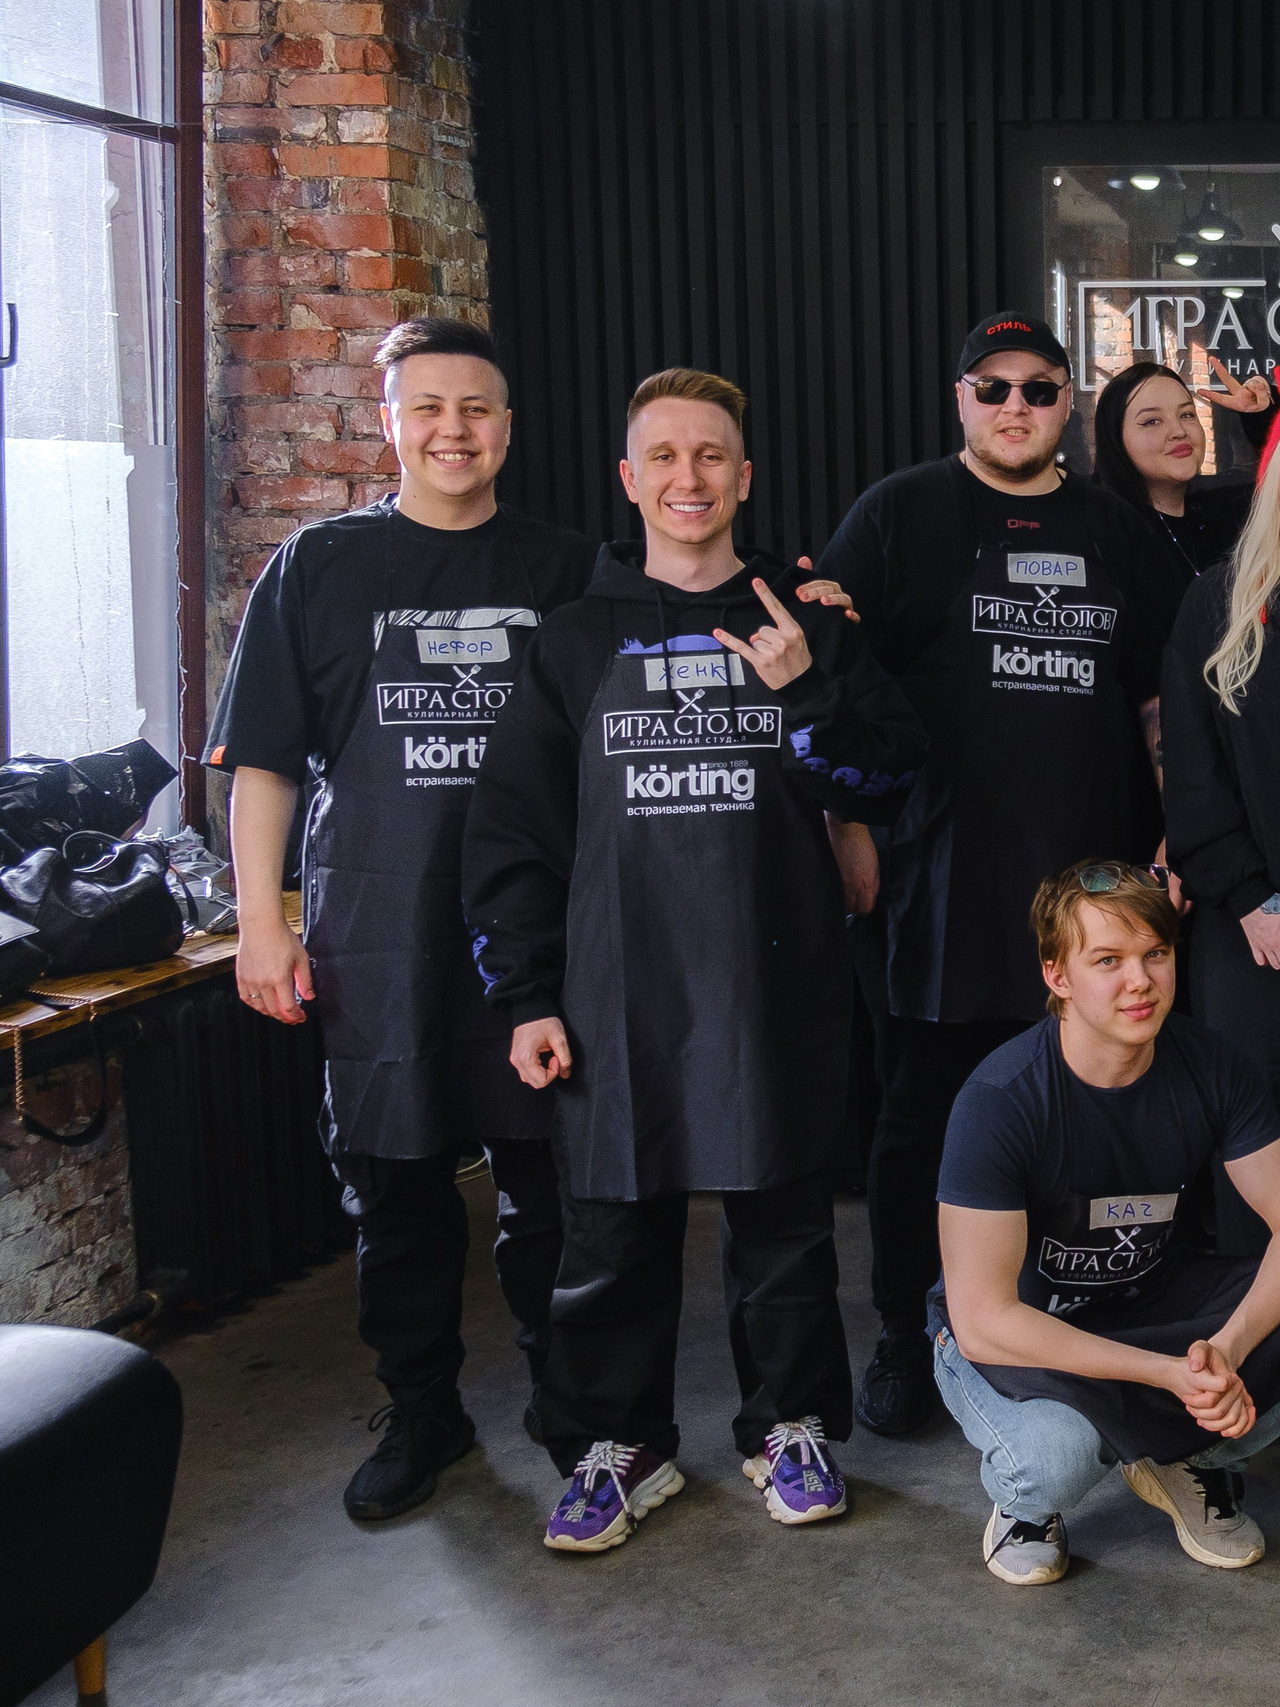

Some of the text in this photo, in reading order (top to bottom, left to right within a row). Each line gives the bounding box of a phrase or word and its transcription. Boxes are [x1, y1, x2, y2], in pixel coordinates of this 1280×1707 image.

[986, 321, 1032, 336] СТИЛЬ
[1015, 560, 1079, 577] ПОВАР
[979, 600, 1112, 631] ИГРА СТОЛОВ
[997, 622, 1056, 635] КУЛИНАРНАЯ
[993, 644, 1096, 688] körting
[991, 679, 1095, 696] встраиваемая техника
[383, 688, 513, 710] ИГРА СТО
[407, 711, 479, 719] КУЛИНАРНАЯ
[609, 715, 669, 739] ИГРА
[629, 736, 700, 747] КУЛИНАРНАЯ
[404, 736, 488, 769] körti
[730, 759, 749, 768] 1889
[405, 776, 477, 788] встраиваем
[626, 764, 755, 801] körting
[627, 801, 756, 818] встраиваемая техника
[1045, 1244, 1100, 1273] ИГРА
